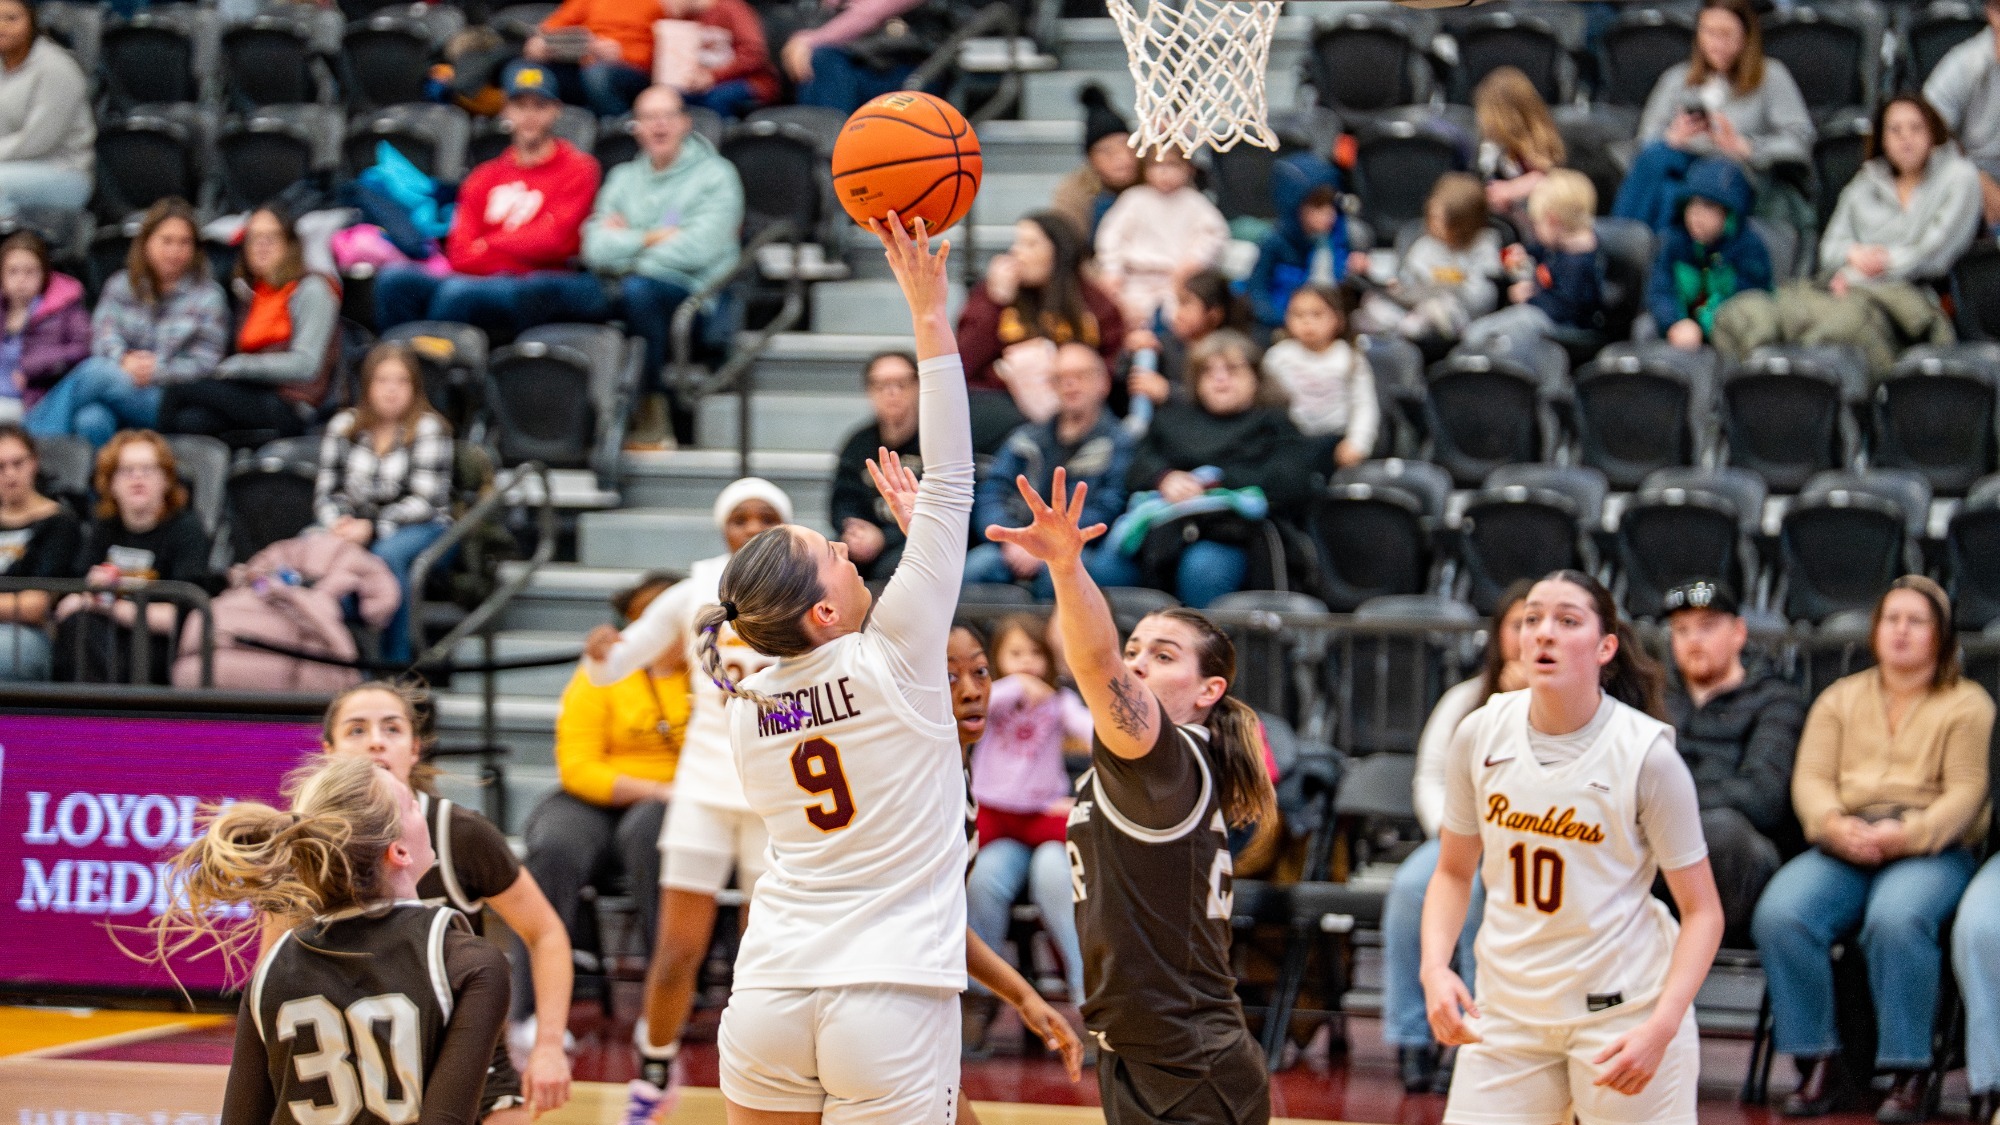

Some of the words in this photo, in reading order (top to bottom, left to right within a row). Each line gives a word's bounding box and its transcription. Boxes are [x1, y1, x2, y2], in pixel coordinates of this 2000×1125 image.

[21, 791, 238, 848] LOYOL
[789, 735, 858, 834] 9
[1485, 792, 1606, 845] Ramblers
[1508, 840, 1565, 915] 10
[275, 992, 422, 1125] 30
